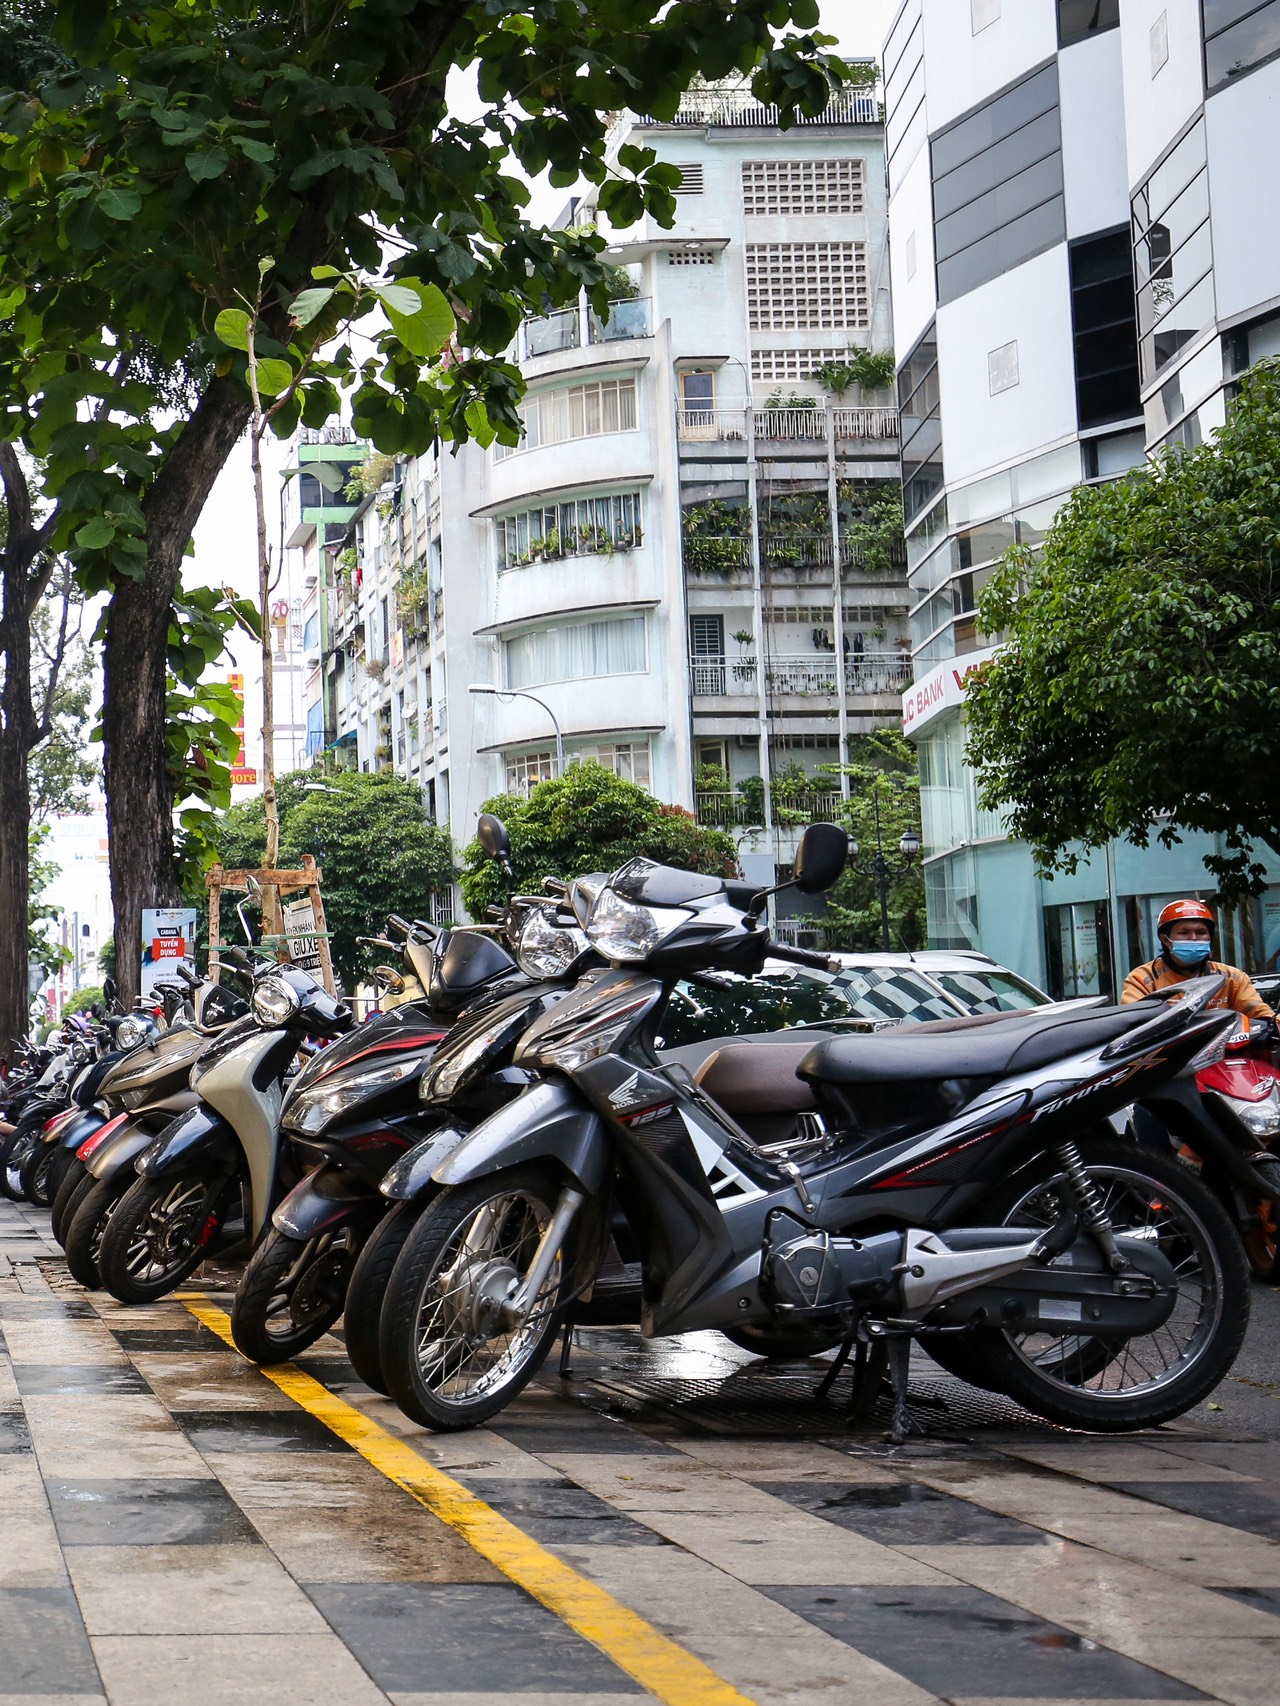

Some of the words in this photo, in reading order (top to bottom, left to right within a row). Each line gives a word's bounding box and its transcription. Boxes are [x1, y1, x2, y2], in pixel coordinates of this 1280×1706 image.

[916, 675, 944, 715] BANK
[1030, 1067, 1130, 1124] FUTURE
[630, 1104, 673, 1127] 125
[958, 1132, 991, 1150] SPORTS
